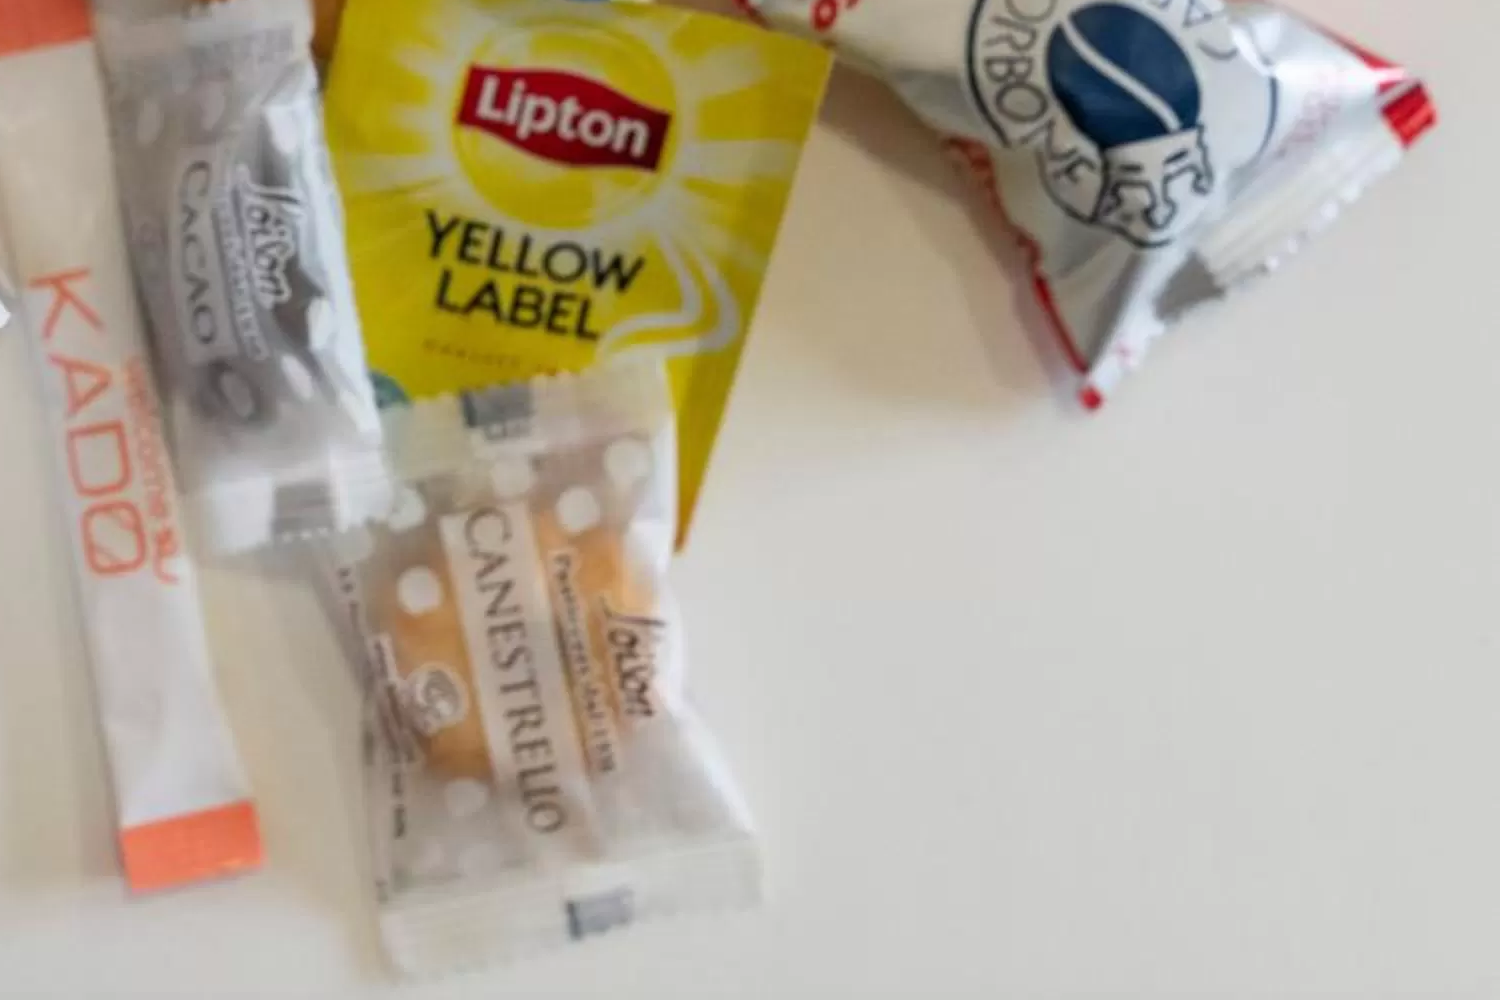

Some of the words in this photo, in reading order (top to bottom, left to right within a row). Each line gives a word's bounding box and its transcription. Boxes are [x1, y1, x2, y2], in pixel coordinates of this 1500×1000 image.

[475, 73, 650, 157] Lipton
[179, 158, 218, 347] CACAO
[426, 208, 645, 294] YELLOW
[435, 269, 599, 342] LABEL
